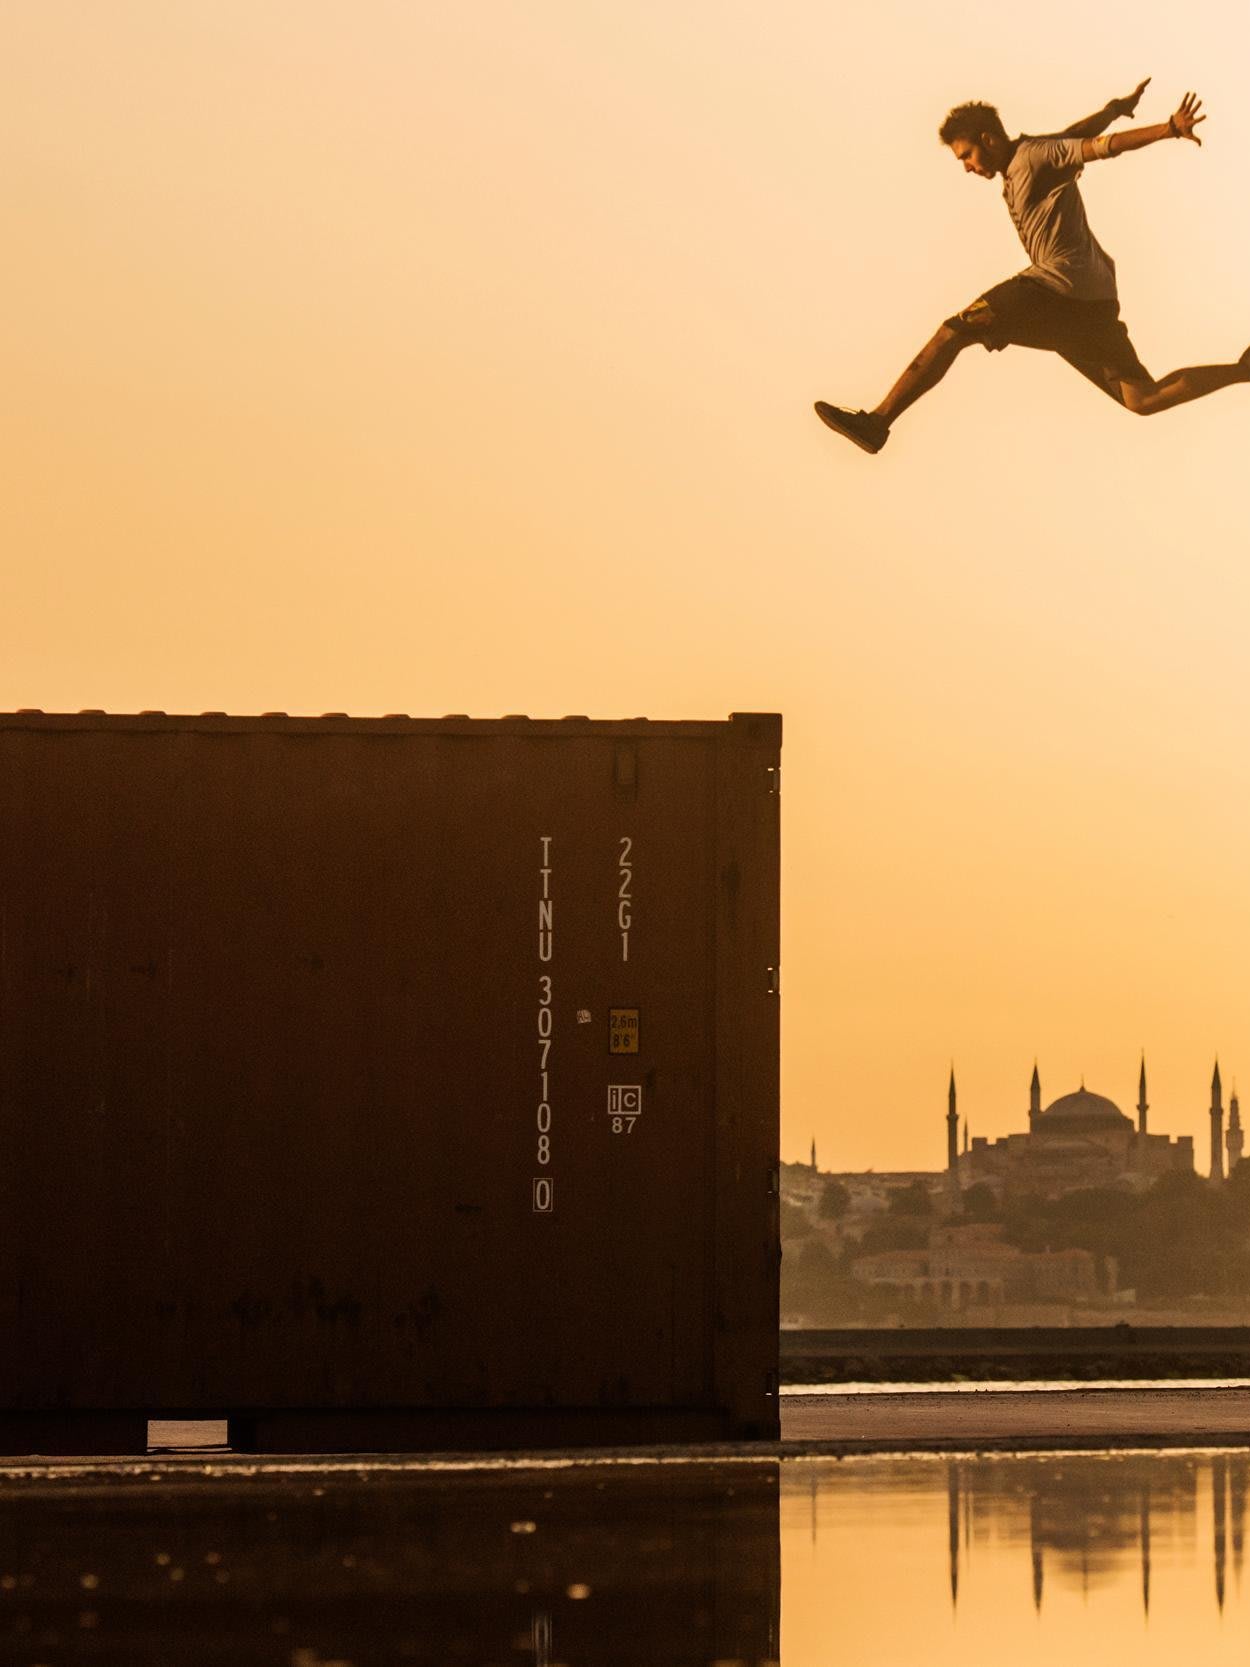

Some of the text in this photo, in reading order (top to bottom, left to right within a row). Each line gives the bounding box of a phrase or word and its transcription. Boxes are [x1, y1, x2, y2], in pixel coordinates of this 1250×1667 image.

[618, 836, 633, 962] 22G1
[535, 836, 553, 1210] TTNU 307108 0
[611, 1116, 637, 1134] 87
